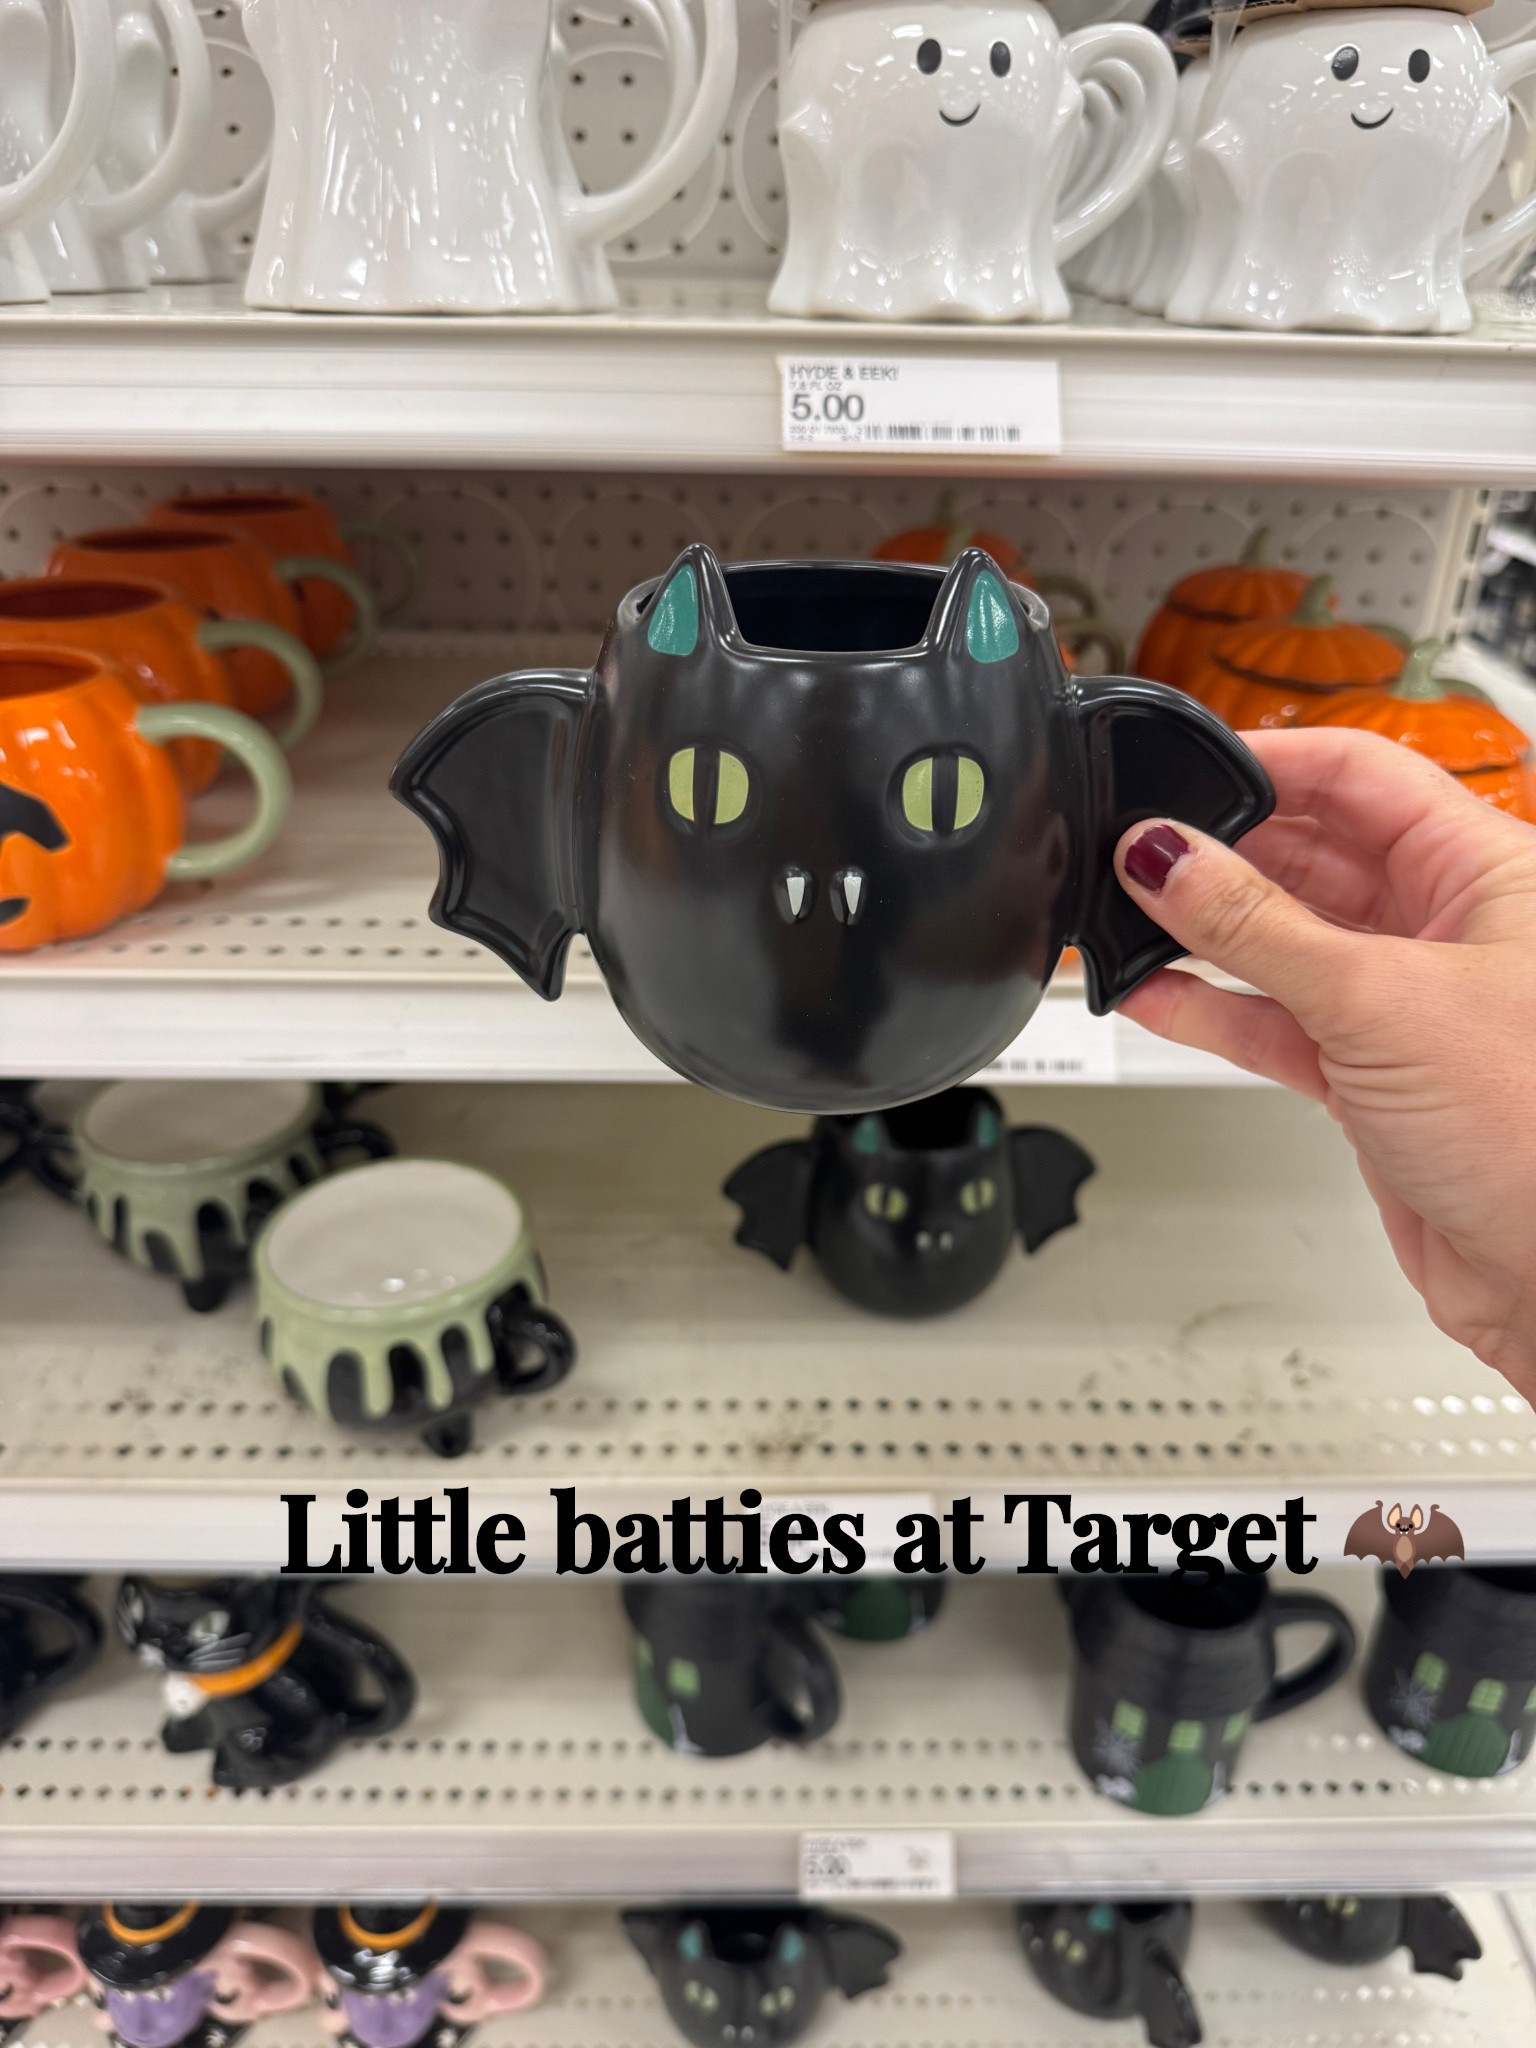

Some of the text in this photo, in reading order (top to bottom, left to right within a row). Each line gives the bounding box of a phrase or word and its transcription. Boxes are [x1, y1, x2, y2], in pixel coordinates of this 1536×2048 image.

[789, 366, 838, 380] HYDE
[843, 366, 855, 380] &
[791, 393, 864, 421] 5.00
